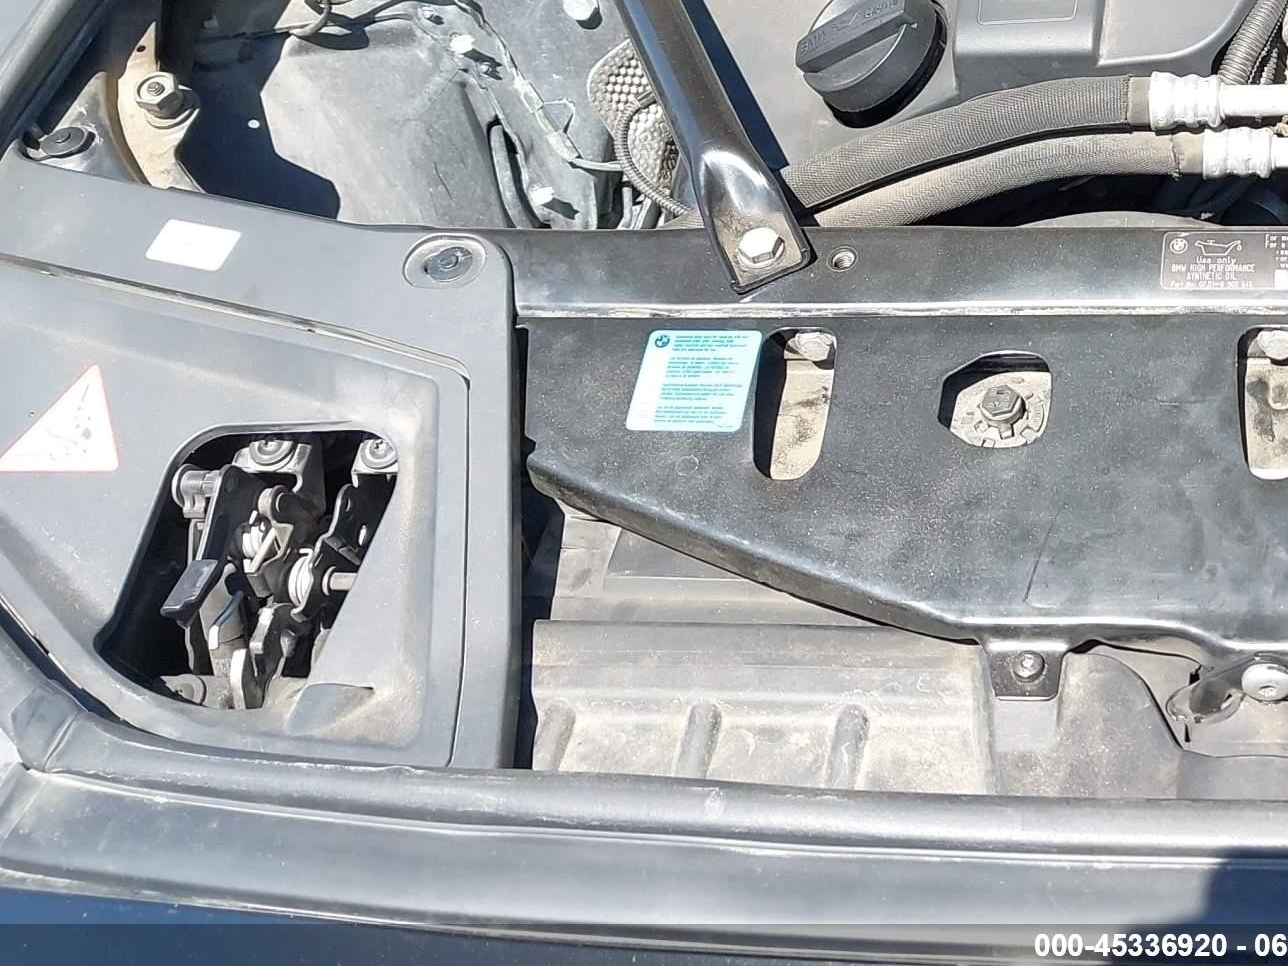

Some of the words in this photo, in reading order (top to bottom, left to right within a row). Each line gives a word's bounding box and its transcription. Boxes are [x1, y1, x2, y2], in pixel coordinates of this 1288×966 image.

[1265, 234, 1277, 242] For
[1196, 256, 1212, 264] Use
[1217, 256, 1237, 266] only
[1171, 264, 1187, 272] BMW
[1189, 264, 1206, 272] HIGH
[1208, 264, 1255, 273] PERFORMANCE
[1186, 272, 1224, 281] SYNTHETIC
[1225, 272, 1237, 281] OIL
